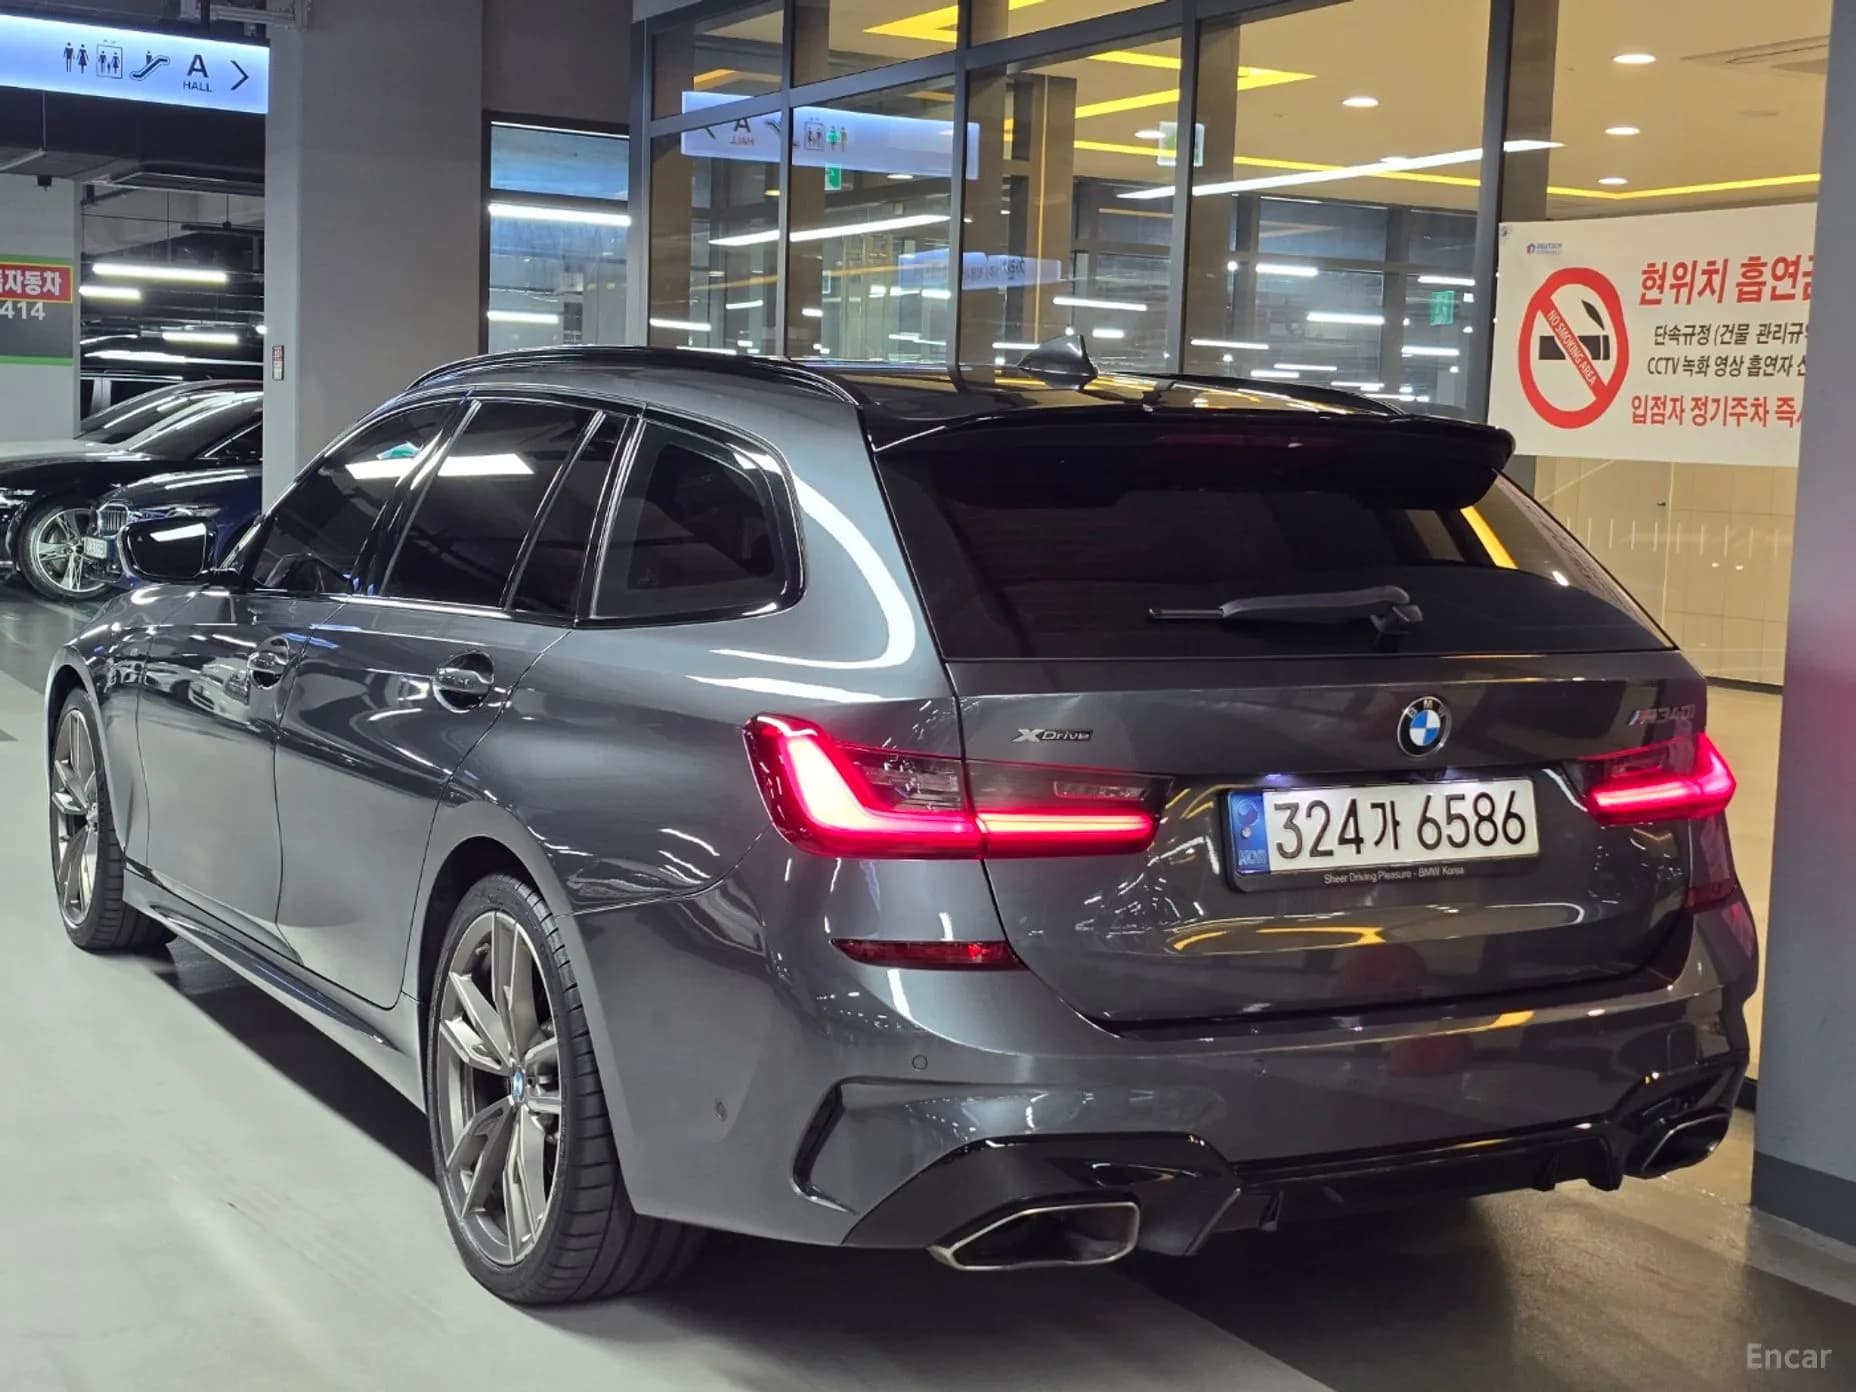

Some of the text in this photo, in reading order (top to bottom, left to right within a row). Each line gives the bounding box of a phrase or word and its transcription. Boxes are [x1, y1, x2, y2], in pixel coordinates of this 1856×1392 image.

[187, 54, 208, 78] A
[183, 80, 212, 93] HALL
[0, 269, 62, 296] 자동차
[1639, 258, 1729, 306] 현위치
[1654, 324, 1712, 347] 단속규정
[1546, 310, 1598, 387] NO SMOKING AREA
[1647, 356, 1680, 375] CCTV
[1682, 355, 1710, 377] 녹화
[1714, 354, 1744, 378] 영상
[1747, 354, 1793, 377] 흡연자
[1631, 394, 1685, 426] 입점자
[1690, 395, 1770, 428] 정기주차
[1274, 790, 1526, 860] 324가 6586
[1324, 873, 1348, 884] Sheer
[1350, 871, 1377, 883] Driving
[1378, 869, 1412, 881] Pleasure
[1418, 866, 1440, 877] BMW
